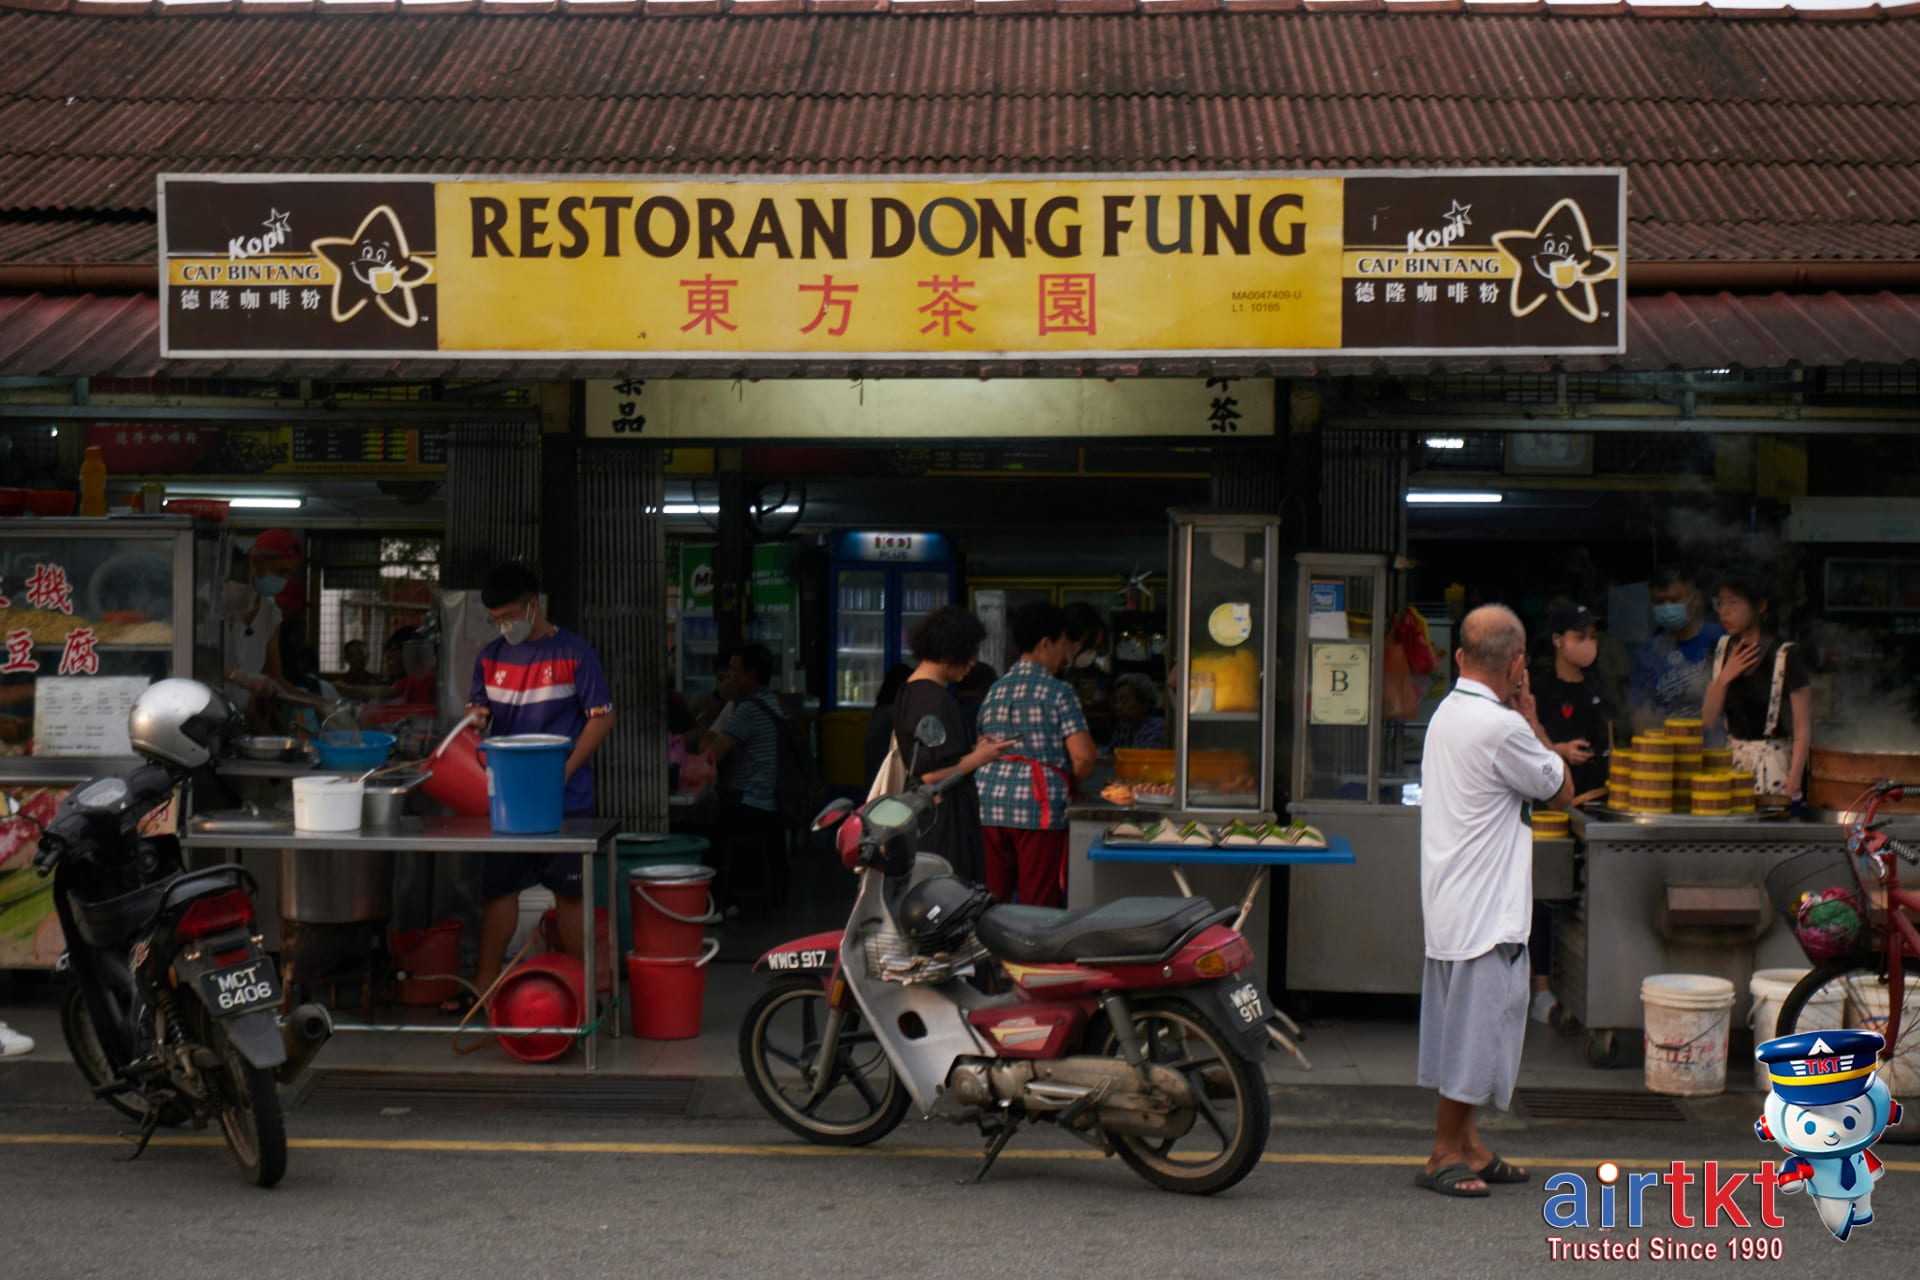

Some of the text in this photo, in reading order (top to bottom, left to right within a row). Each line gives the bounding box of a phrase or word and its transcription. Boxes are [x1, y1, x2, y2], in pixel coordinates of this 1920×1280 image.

[470, 194, 1307, 260] RESTORAN DONG FUNG
[1406, 215, 1465, 254] Kopi
[228, 222, 286, 260] Kopi
[182, 264, 320, 281] CAP BINTANG
[1357, 258, 1500, 274] CAP BINTANG
[180, 289, 321, 310] 德隆咖啡粉
[680, 273, 1096, 337] 東方茶園
[1355, 282, 1501, 304] 德隆咖啡粉
[0, 628, 99, 675] 豆腐
[1330, 669, 1349, 692] B
[768, 949, 827, 970] WWG 917
[217, 966, 256, 992] MCT
[218, 981, 272, 1009] 6406
[1240, 998, 1264, 1023] 917
